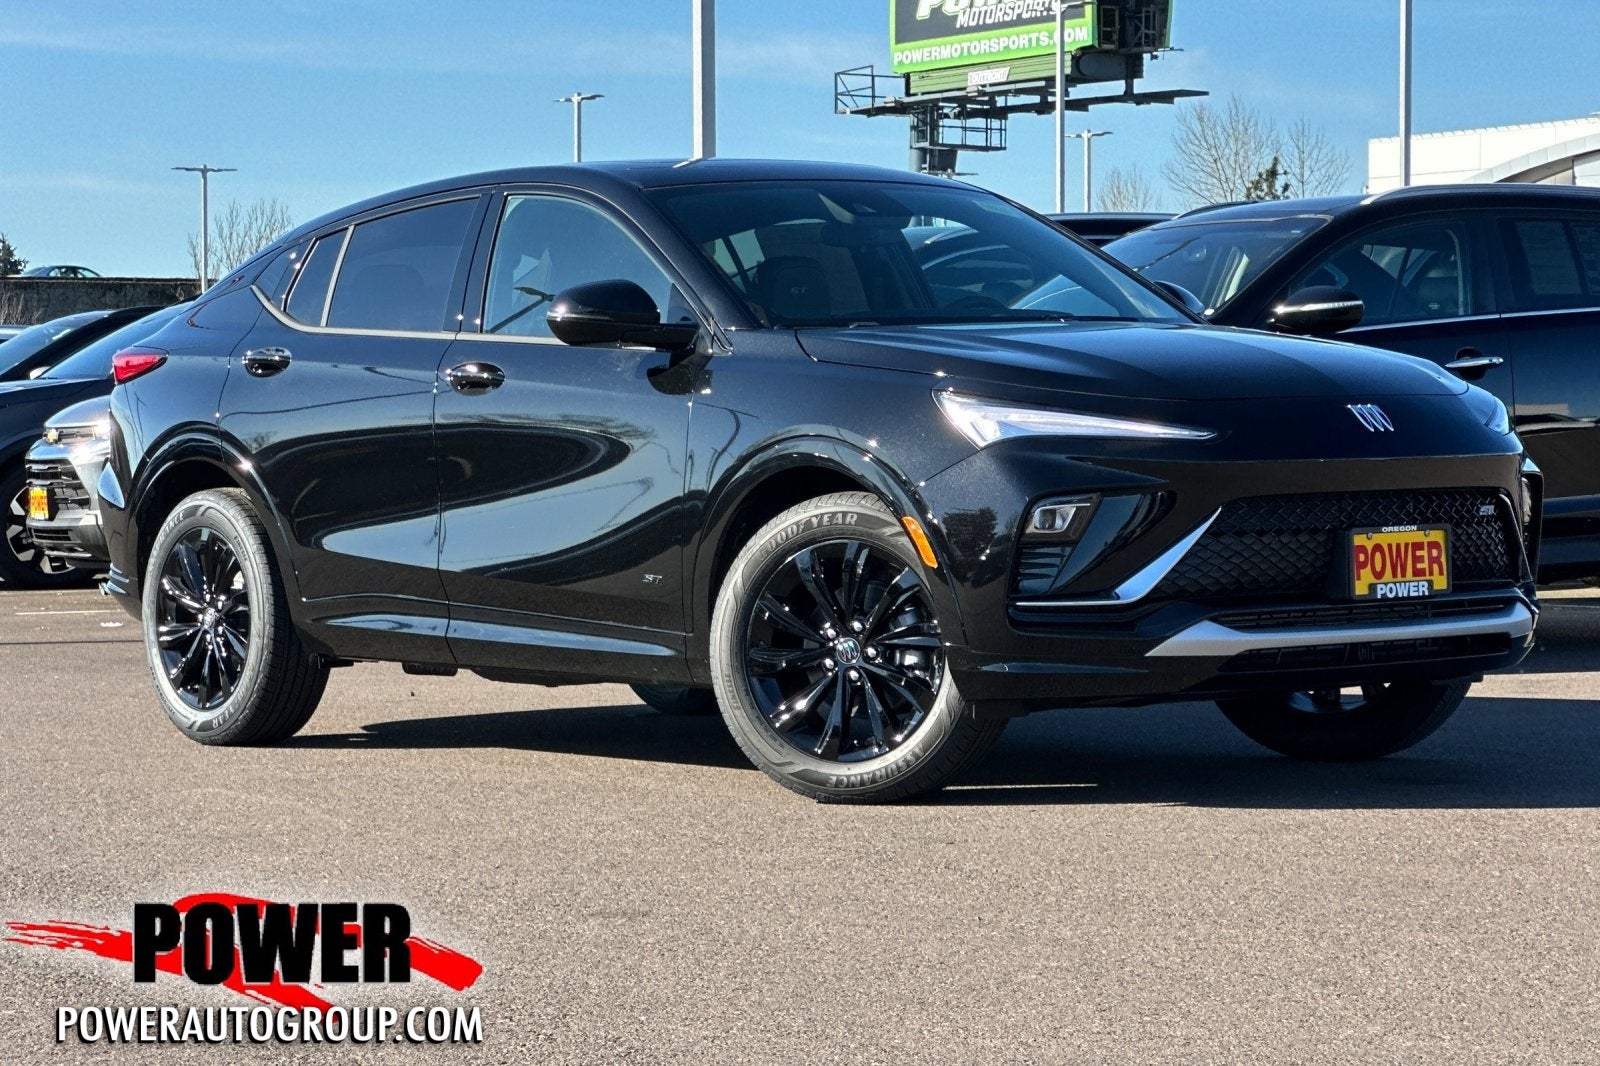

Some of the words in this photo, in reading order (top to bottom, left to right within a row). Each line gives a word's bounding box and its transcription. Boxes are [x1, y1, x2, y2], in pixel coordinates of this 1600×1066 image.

[1382, 525, 1417, 533] OREGON
[1355, 541, 1444, 581] POWER
[1377, 581, 1429, 598] POWER
